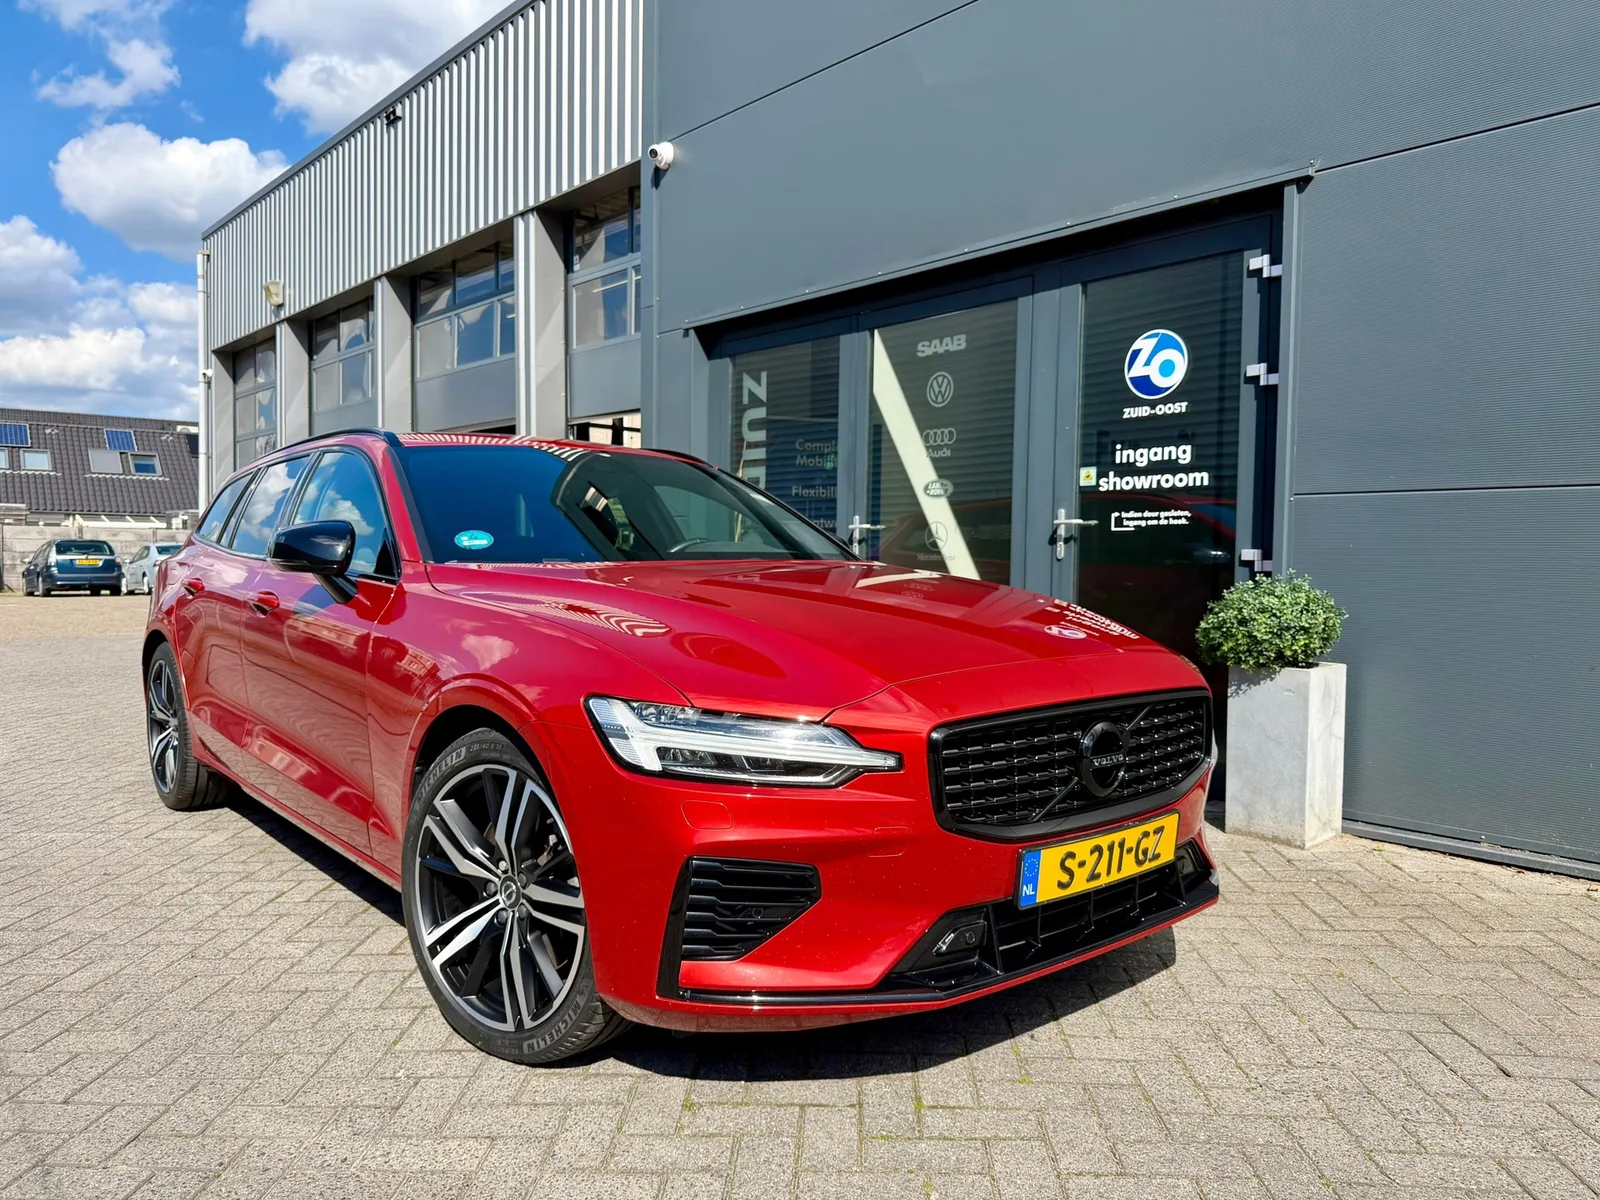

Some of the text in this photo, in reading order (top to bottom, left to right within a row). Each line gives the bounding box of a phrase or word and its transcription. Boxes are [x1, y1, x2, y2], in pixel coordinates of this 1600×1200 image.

[916, 334, 967, 357] SAAB
[1122, 402, 1188, 419] ZUID-OOST
[795, 438, 838, 454] Compl
[927, 448, 951, 457] Audi
[1115, 444, 1192, 467] ingang
[1098, 471, 1209, 491] showroom
[1123, 519, 1146, 527] ingang
[1092, 754, 1124, 766] VOLVO
[417, 747, 466, 807] MICHELIN
[1057, 825, 1165, 890] S-211-GZ
[1022, 883, 1036, 896] NL
[525, 1000, 582, 1054] MICHELIN
